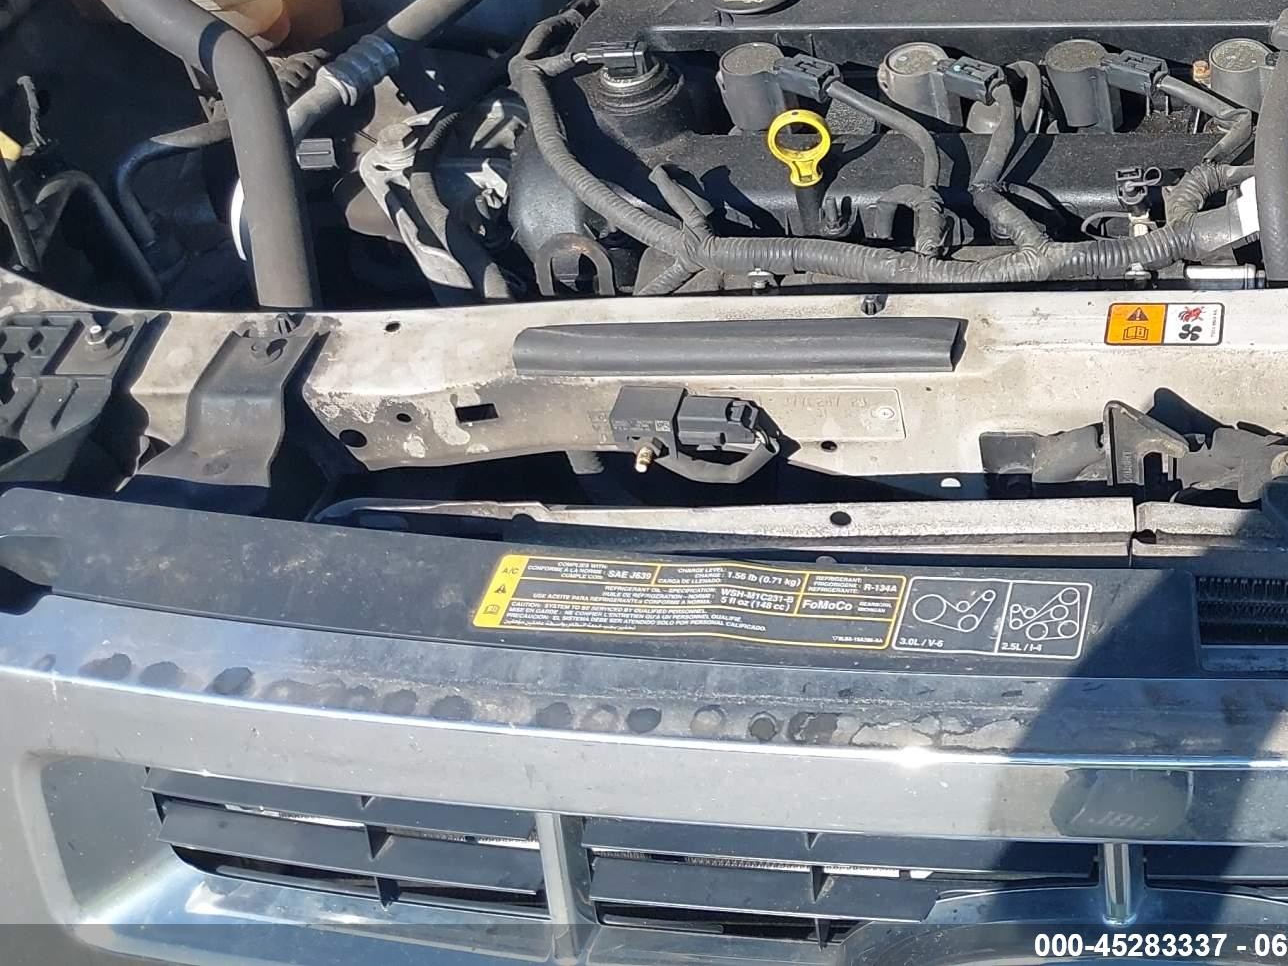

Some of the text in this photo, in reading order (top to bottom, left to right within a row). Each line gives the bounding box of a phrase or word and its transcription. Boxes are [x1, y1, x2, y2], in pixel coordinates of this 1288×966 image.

[503, 567, 519, 575] A/C
[607, 570, 652, 580] SAE J639
[727, 572, 802, 588] 1.56 lb (0.71 kg)
[863, 583, 898, 593] R-134A
[721, 589, 794, 604] WSH-M1C231-B
[750, 599, 772, 610] (148
[802, 599, 853, 611] FoMoCo
[899, 637, 920, 646] 3.0L
[928, 638, 945, 648] V-6
[1001, 642, 1022, 651] 2.5L
